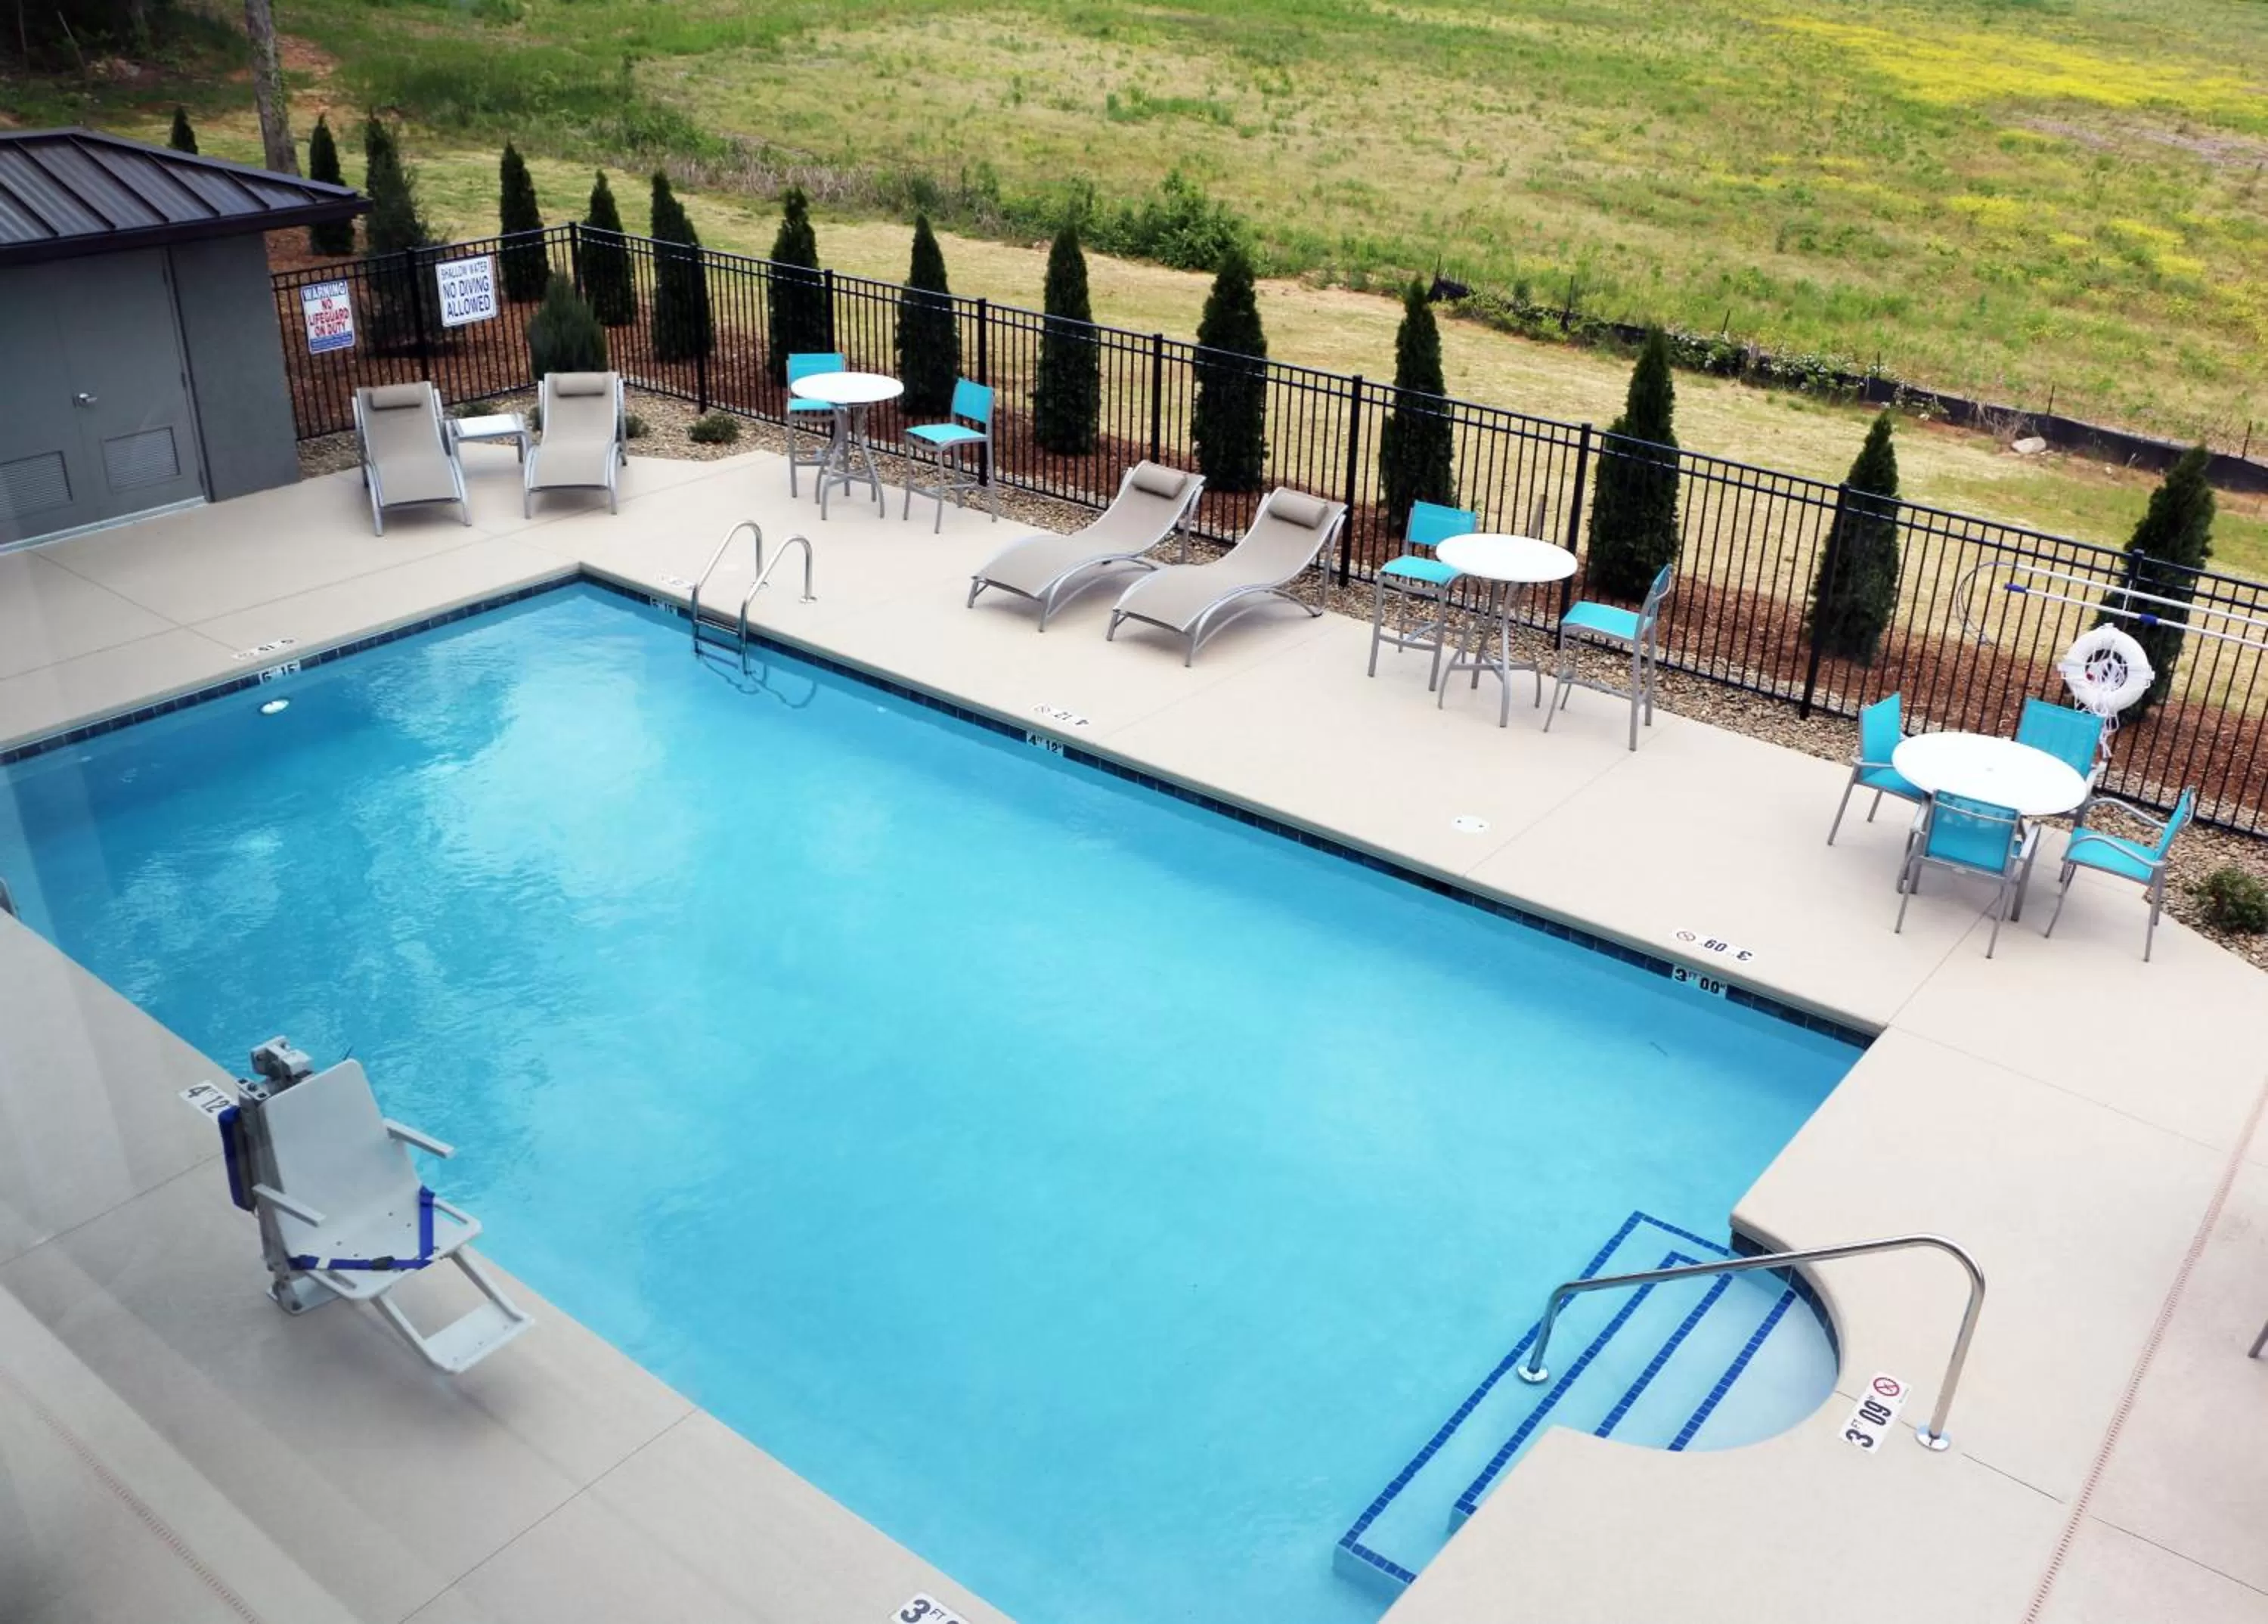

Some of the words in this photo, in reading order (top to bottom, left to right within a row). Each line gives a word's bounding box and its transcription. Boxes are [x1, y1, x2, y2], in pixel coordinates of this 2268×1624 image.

[468, 261, 488, 274] WATER
[303, 280, 347, 301] WARNING
[442, 280, 457, 300] NO
[459, 275, 490, 297] DIVING
[321, 296, 333, 309] NO
[447, 294, 491, 318] ALLOWED
[308, 307, 349, 326] LIFEGUARD
[314, 325, 326, 336] ON
[327, 321, 345, 334] DUTY
